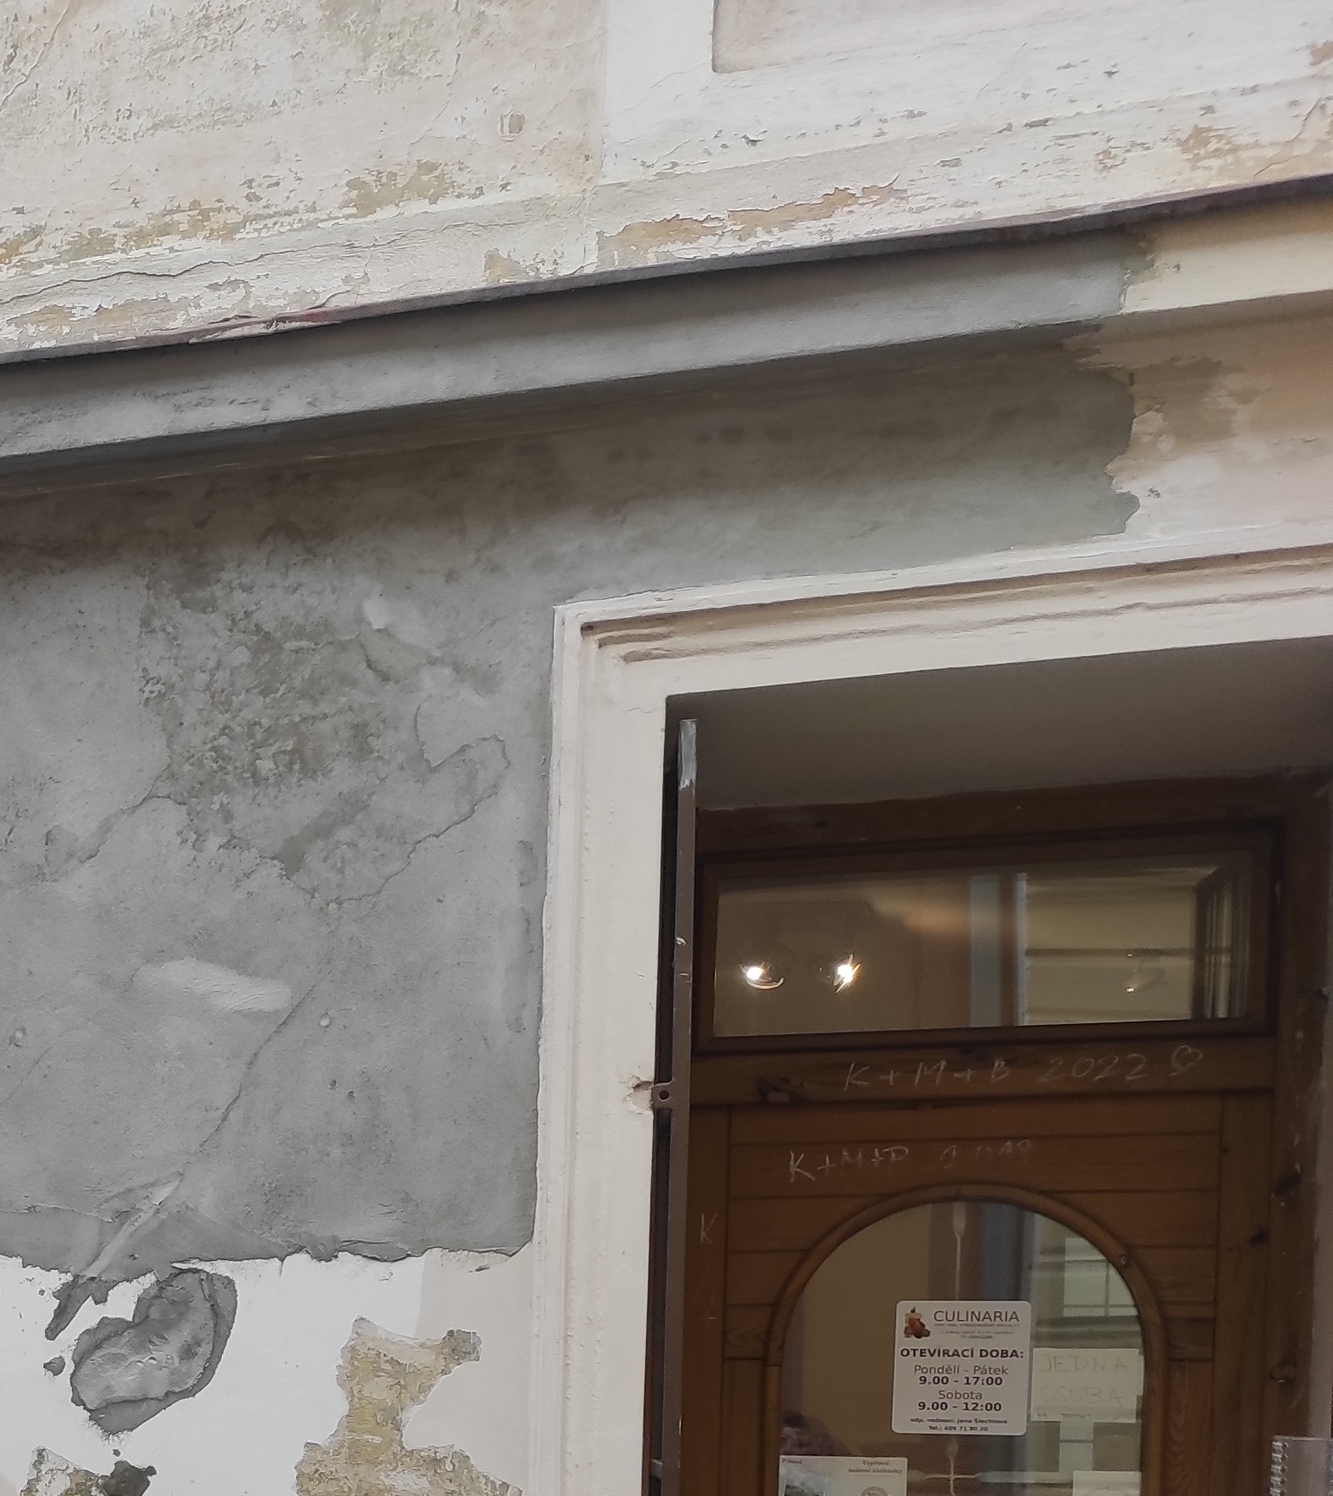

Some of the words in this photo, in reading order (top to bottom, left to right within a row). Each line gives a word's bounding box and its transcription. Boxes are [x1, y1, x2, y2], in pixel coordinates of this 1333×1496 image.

[1036, 1053, 1146, 1084] 2022
[933, 1310, 1020, 1323] CULINARIA
[900, 1346, 974, 1359] OTEVÍRACÍ
[979, 1348, 1025, 1359] DOBA:
[914, 1364, 961, 1375] Pondělí
[973, 1365, 1009, 1376] Pátek
[918, 1375, 950, 1386] 9.00
[963, 1376, 1004, 1387] 17:00
[938, 1389, 983, 1400] Sobota
[917, 1401, 949, 1412] 9.00
[962, 1402, 1002, 1412] 12:00
